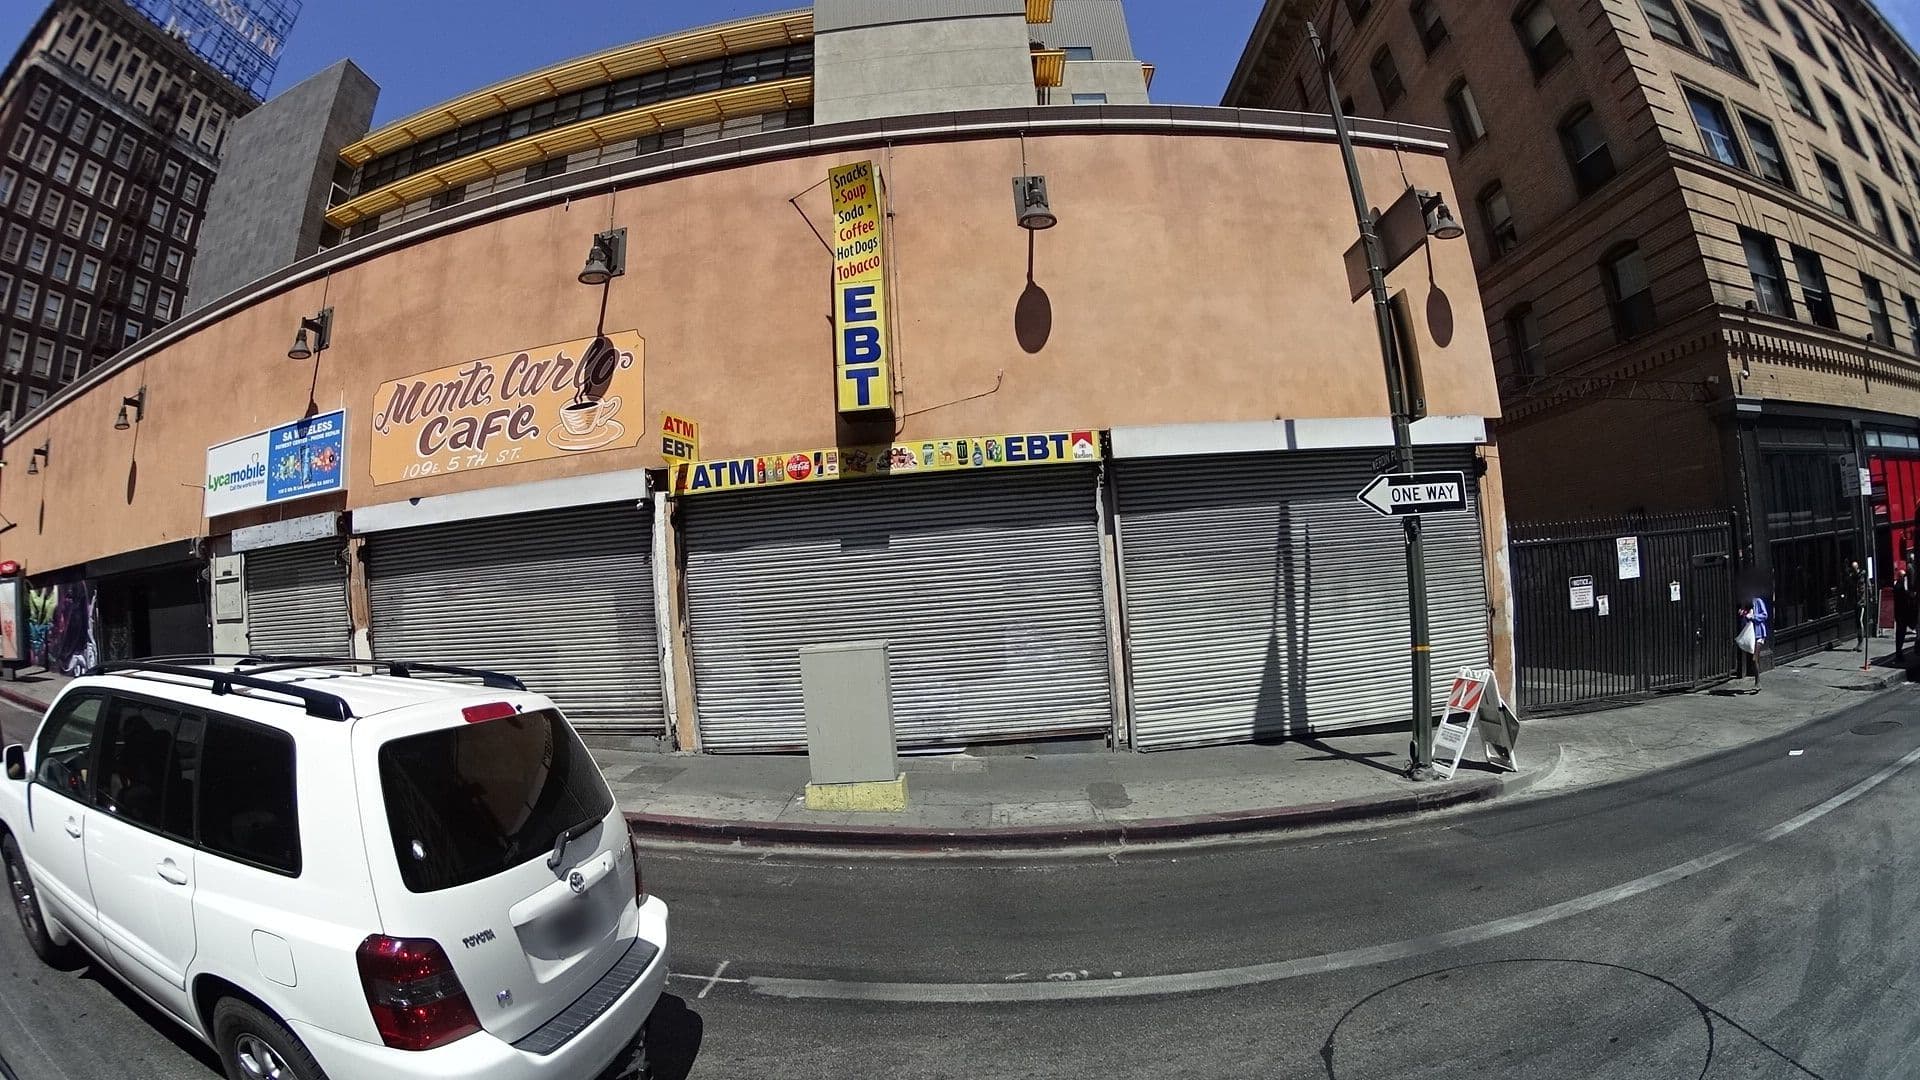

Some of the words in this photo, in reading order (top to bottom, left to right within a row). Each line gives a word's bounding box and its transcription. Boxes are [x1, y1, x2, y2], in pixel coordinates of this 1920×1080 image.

[833, 165, 868, 189] Snacks
[841, 184, 866, 203] Soup
[839, 204, 864, 224] Soda
[839, 220, 875, 241] Coffee
[837, 244, 854, 261] Hot
[855, 236, 878, 254] Dogs
[837, 255, 880, 281] Tobacco
[844, 286, 881, 406] EBT
[374, 359, 495, 435] Monte
[500, 336, 634, 400] Carlo
[282, 432, 292, 442] SA
[294, 420, 333, 438] WIRELESS
[663, 415, 694, 438] ATM
[662, 437, 694, 460] EBT
[1005, 434, 1068, 462] EBT
[208, 462, 266, 491] Lycamobile
[691, 459, 755, 490] ATM
[1391, 486, 1421, 503] ONE
[1426, 485, 1454, 500] WAY
[462, 928, 496, 949] TOYOTA
